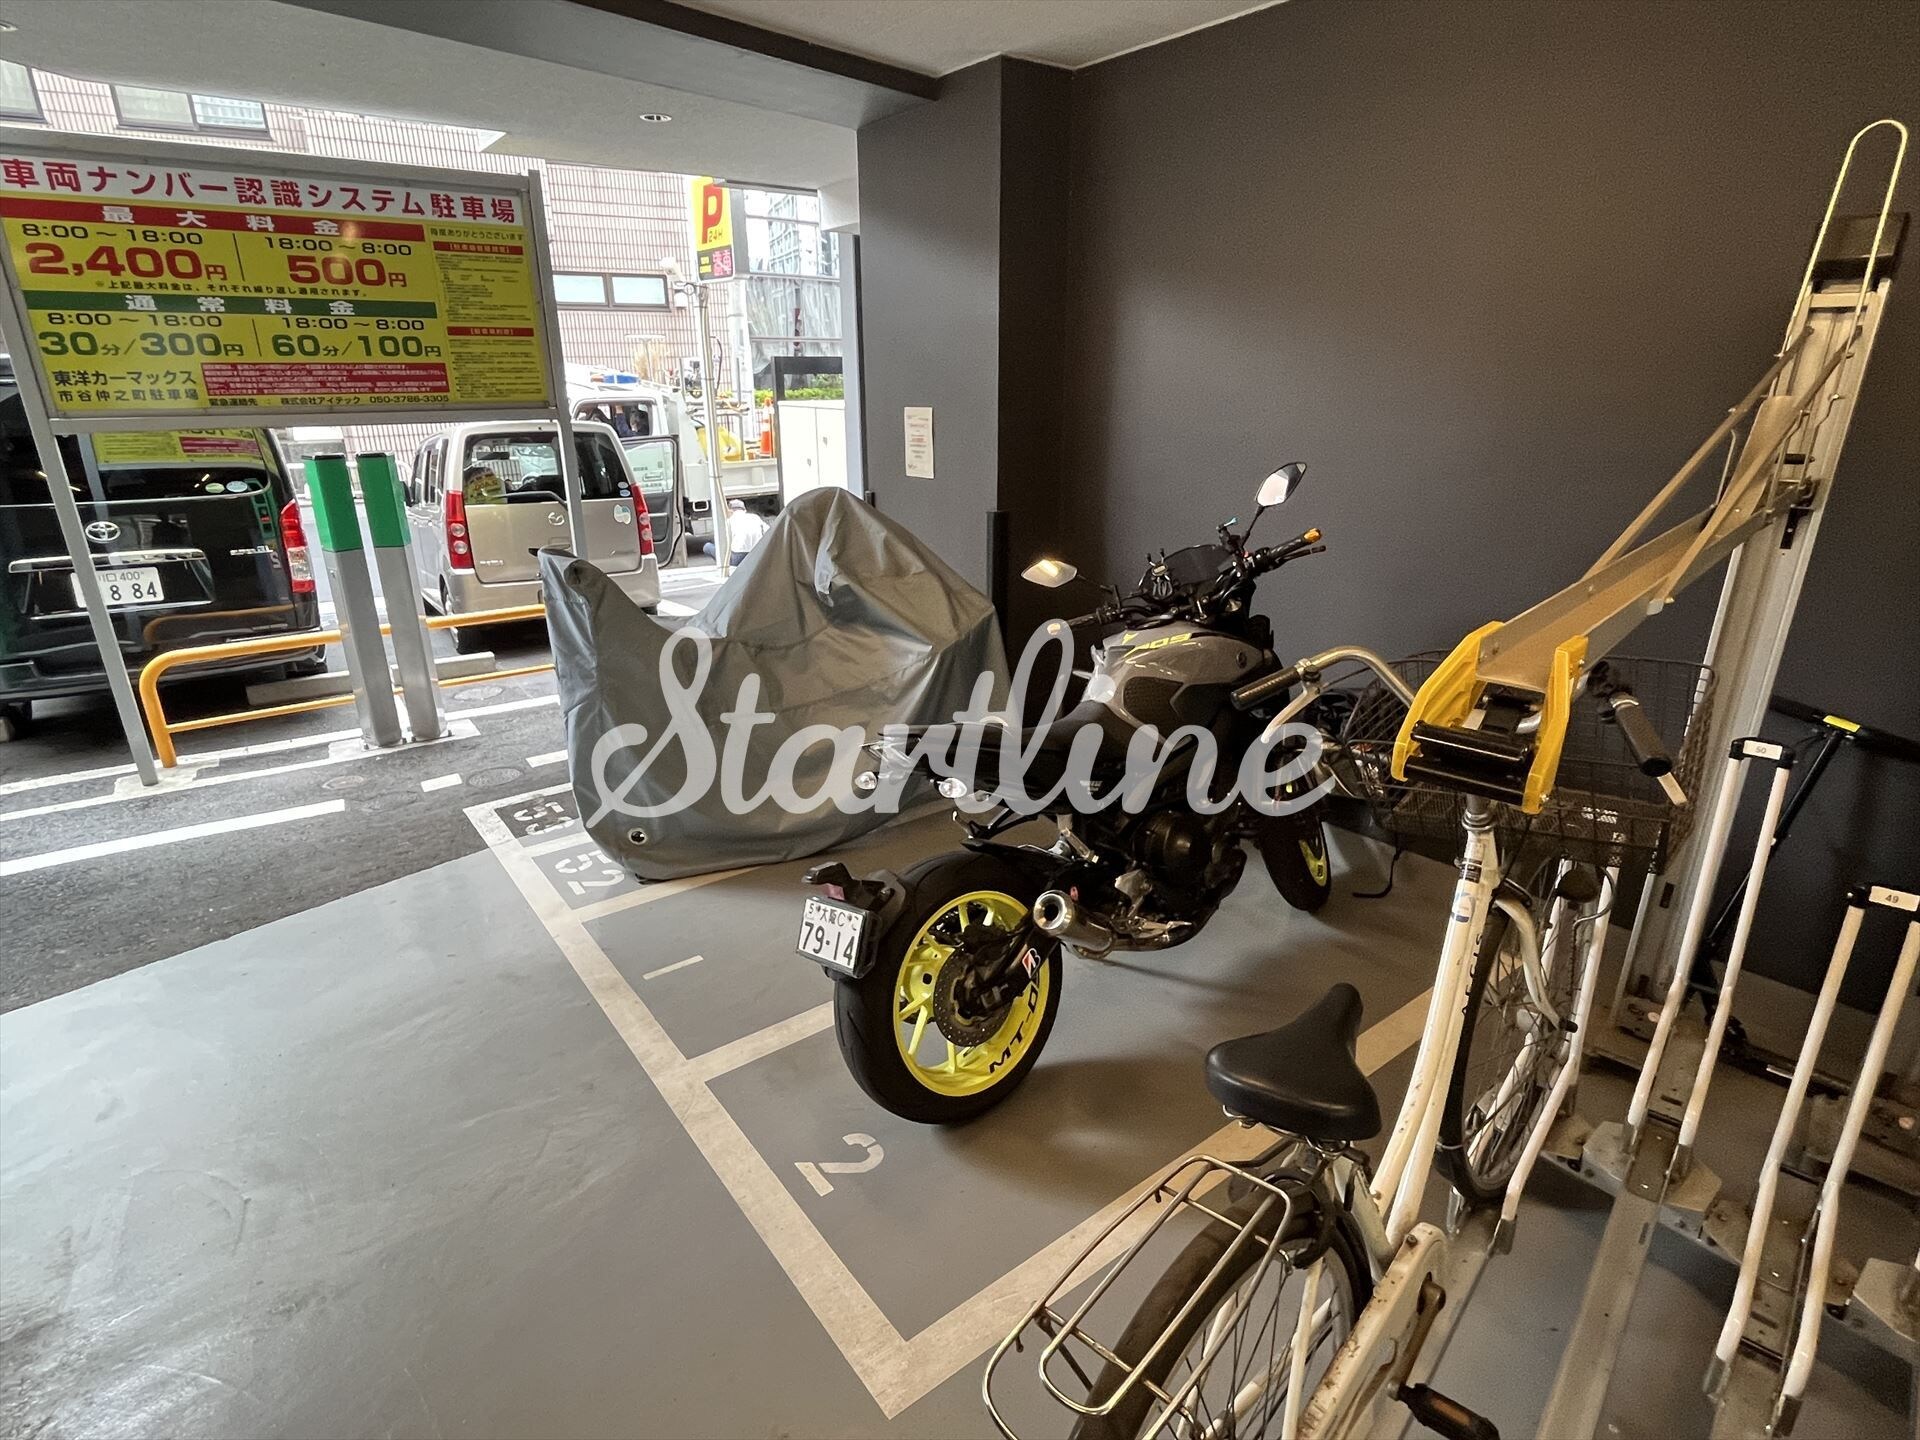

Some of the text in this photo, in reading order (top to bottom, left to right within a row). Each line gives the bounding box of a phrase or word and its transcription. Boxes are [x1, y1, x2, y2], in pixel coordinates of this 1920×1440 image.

[0, 158, 515, 223] 車両ナンバー認識システム駐車場
[101, 205, 340, 236] 最大料金
[702, 184, 722, 244] P
[25, 242, 227, 281] 2,400円
[287, 254, 407, 288] 500円
[125, 294, 355, 316] 通常料金
[51, 370, 197, 387] 東洋カーマックス
[57, 388, 199, 403] 市谷仲之町駐車場
[1884, 893, 1900, 904] 49
[989, 968, 1039, 1074] MT-0
[794, 1132, 884, 1197] 2
